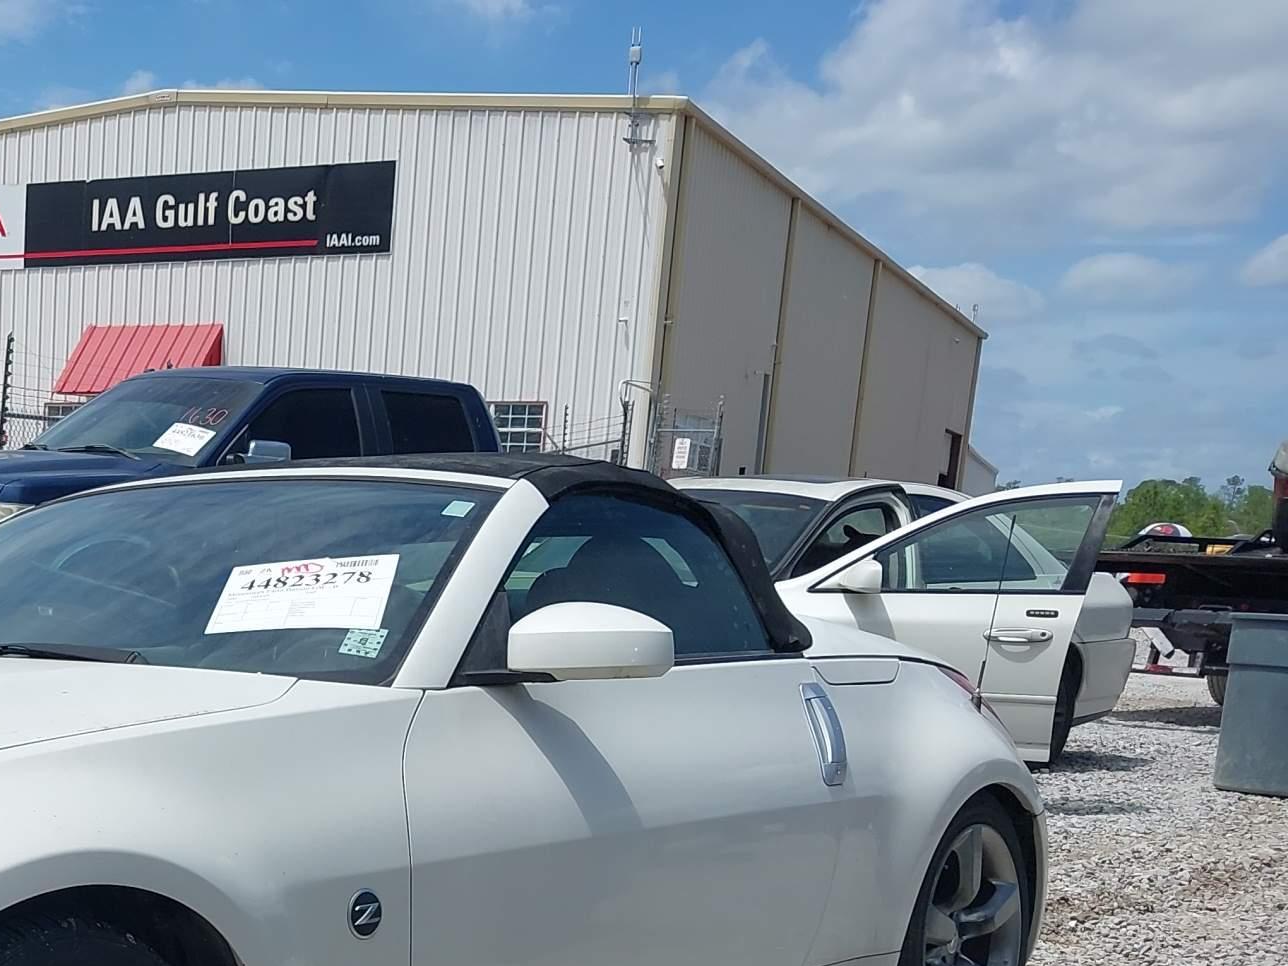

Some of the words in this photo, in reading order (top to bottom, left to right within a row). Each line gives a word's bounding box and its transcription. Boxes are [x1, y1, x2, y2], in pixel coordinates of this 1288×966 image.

[92, 197, 146, 231] IAA
[155, 192, 219, 228] Gulf
[227, 189, 317, 224] Coast
[326, 233, 380, 248] IAAI.com
[241, 571, 372, 591] 44823278
[354, 902, 381, 925] Z
